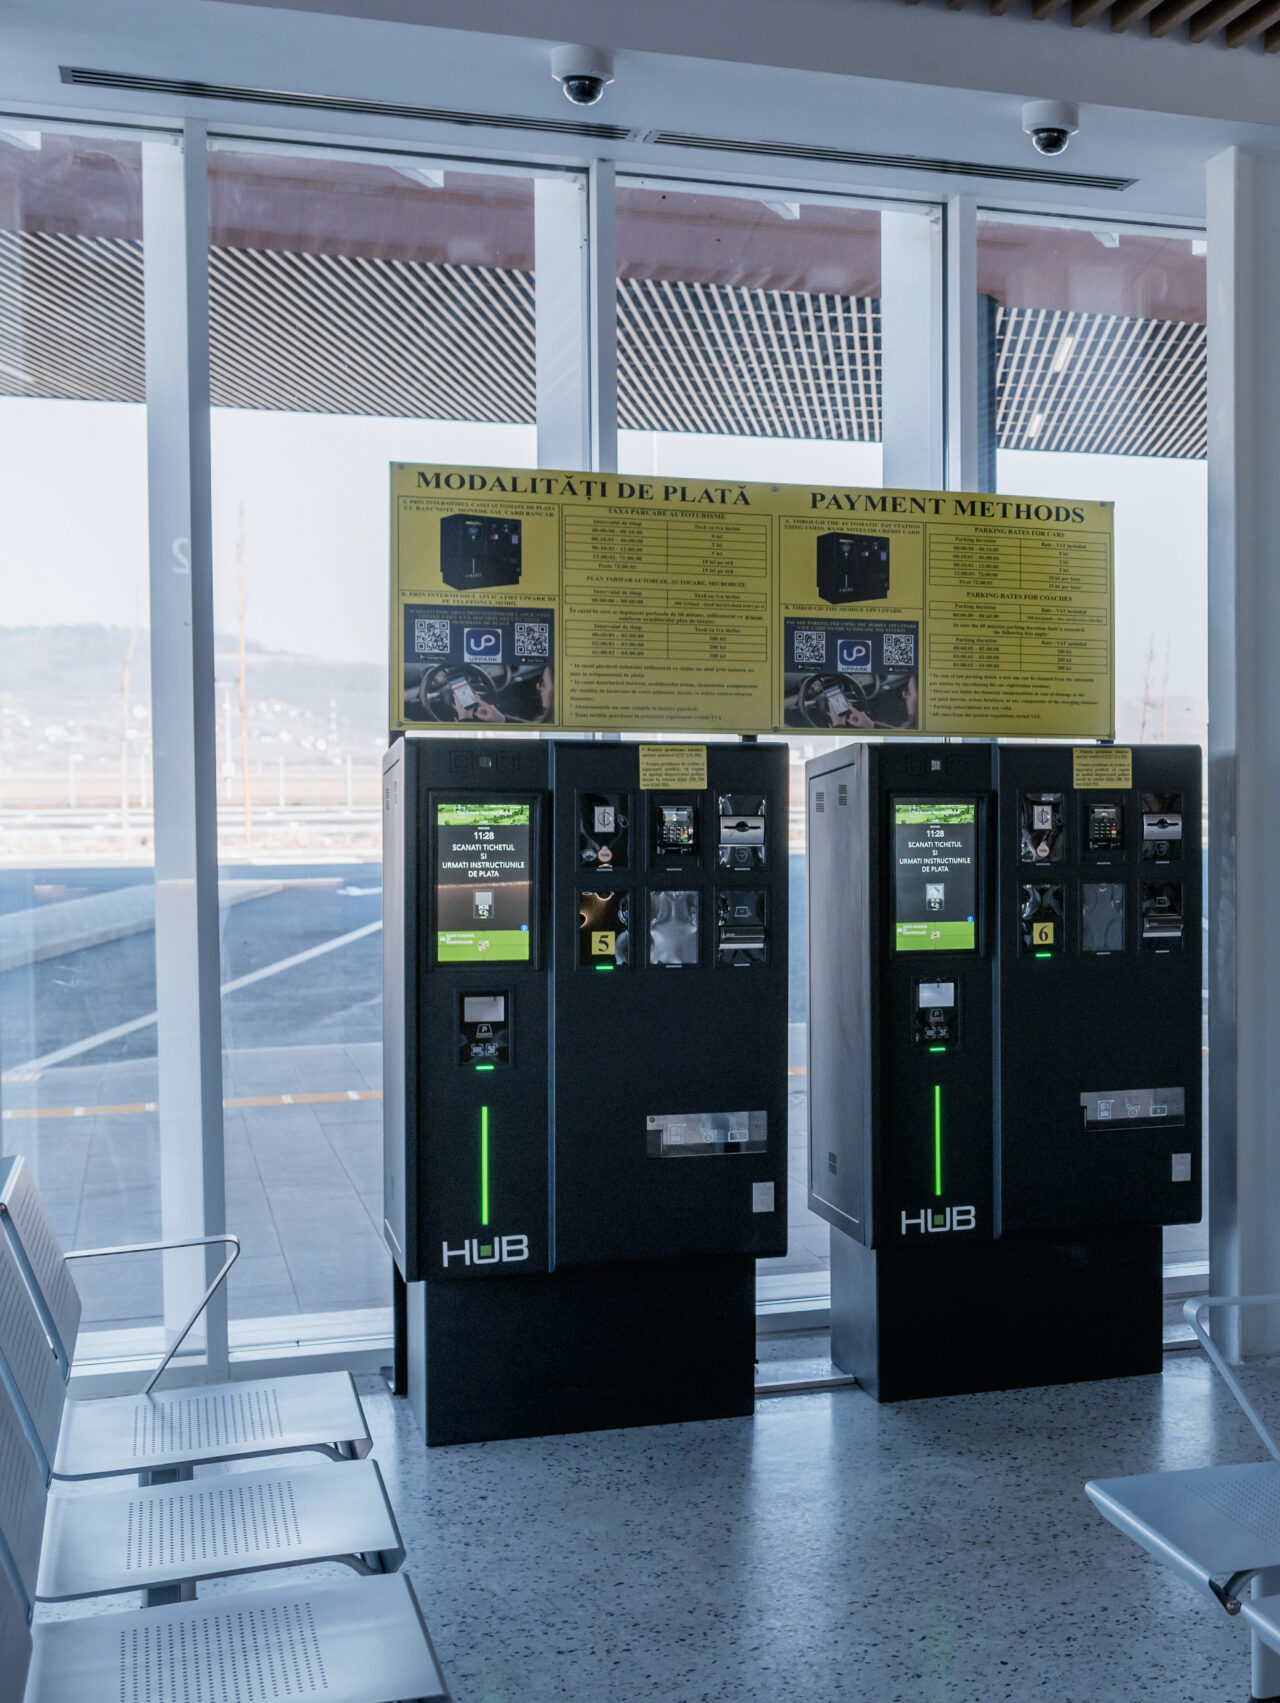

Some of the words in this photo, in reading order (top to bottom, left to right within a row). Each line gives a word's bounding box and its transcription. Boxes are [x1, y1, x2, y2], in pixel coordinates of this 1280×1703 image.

[416, 471, 608, 502] MODALITĂȚI
[616, 481, 654, 501] DE
[663, 484, 752, 506] PLATĂ
[810, 491, 946, 515] PAYMENT
[953, 499, 1085, 524] METHODS
[1008, 528, 1031, 536] RATES
[966, 591, 999, 599] PARKING
[473, 831, 495, 840] 11:28
[926, 829, 945, 838] 11:28
[452, 843, 482, 851] SCANATI
[483, 843, 516, 851] TICHETUL
[480, 852, 487, 860] SI
[442, 861, 469, 869] URMATI
[469, 861, 525, 869] INSTRUCTIUNILE
[468, 870, 478, 878] DE
[1038, 925, 1049, 942] 6
[598, 934, 609, 952] 5
[900, 1205, 976, 1235] HUB
[441, 1233, 530, 1268] HUB
